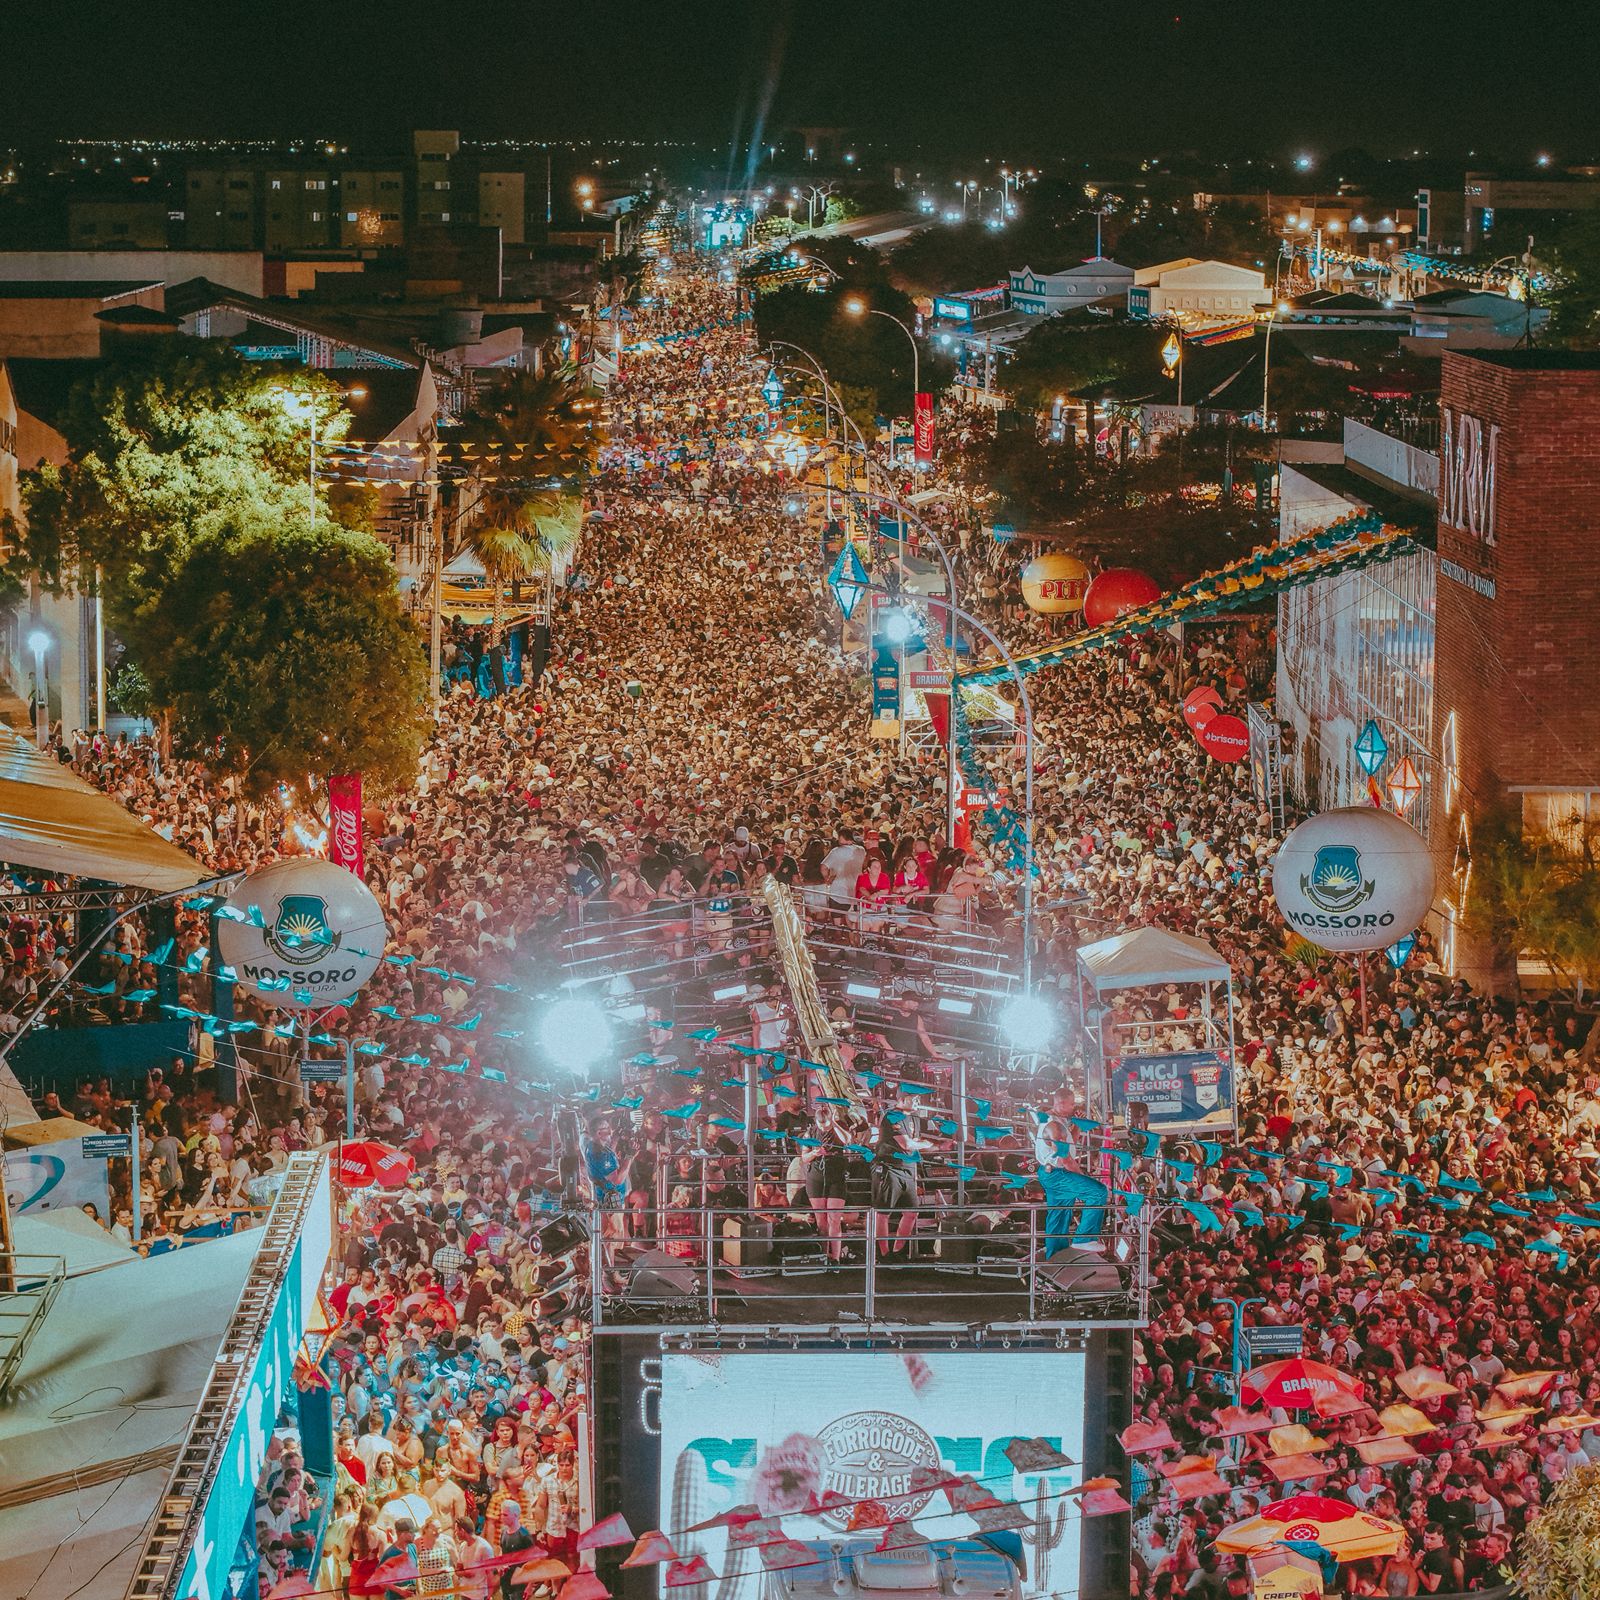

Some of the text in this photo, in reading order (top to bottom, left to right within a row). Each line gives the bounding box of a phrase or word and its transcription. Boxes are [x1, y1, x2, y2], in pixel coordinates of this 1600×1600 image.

[1211, 733, 1248, 746] brisanet
[1287, 910, 1395, 928] MOSSORÓ
[1305, 927, 1376, 938] PREFEITURA
[292, 984, 337, 994] EITURA
[1140, 1063, 1178, 1080] MCJ
[1128, 1080, 1181, 1092] SEGURO
[1281, 1377, 1339, 1393] BRAHMA
[822, 1427, 926, 1465] FORROGODE
[867, 1452, 885, 1472] &
[822, 1469, 912, 1498] FULERAGE
